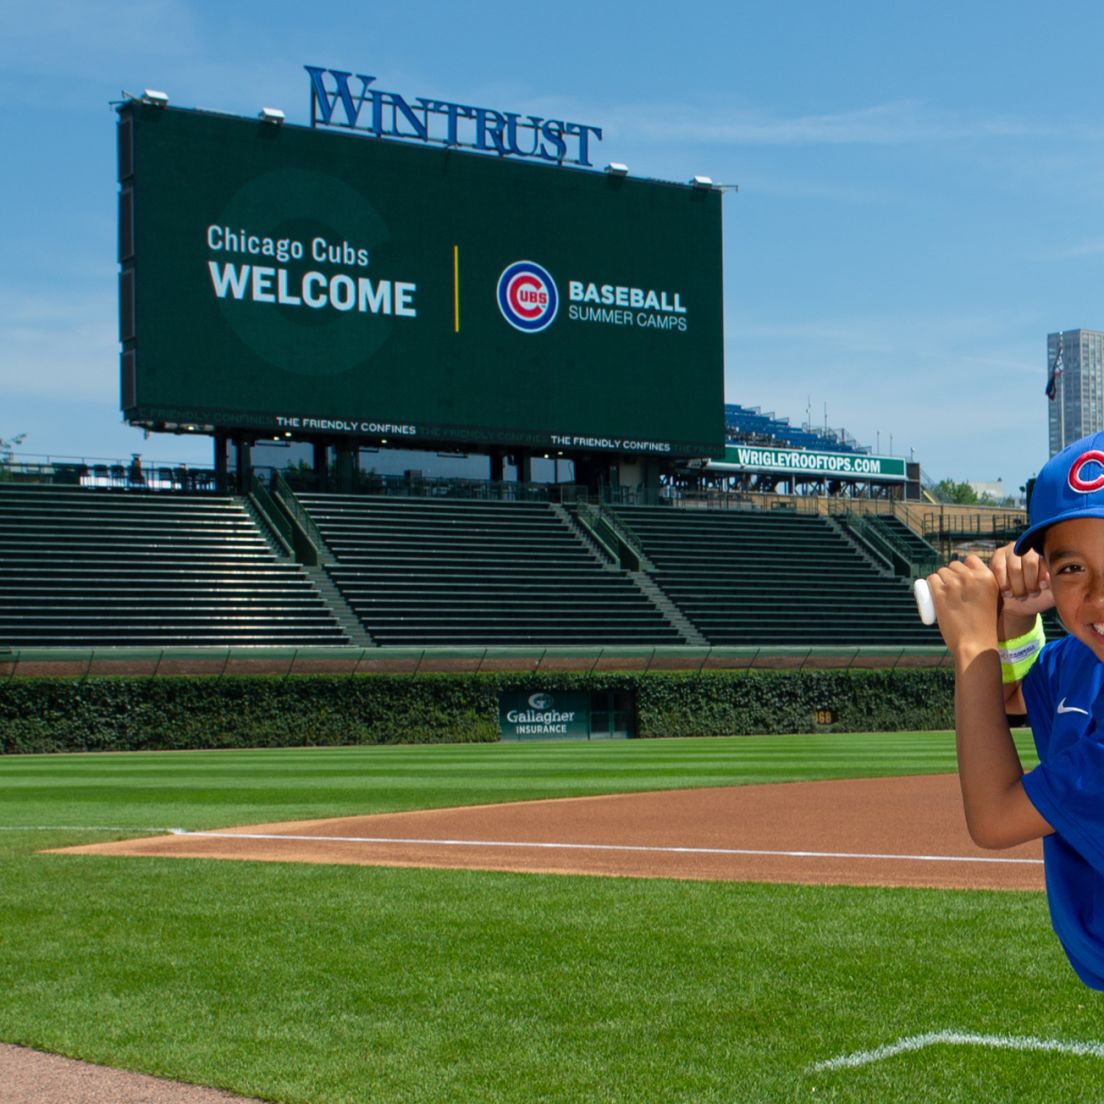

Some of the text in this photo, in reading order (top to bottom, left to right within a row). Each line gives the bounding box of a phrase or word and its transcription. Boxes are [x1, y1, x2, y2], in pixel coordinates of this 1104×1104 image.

[303, 65, 603, 167] WINTRUST
[207, 224, 369, 266] Chicago Cubs
[207, 260, 417, 317] WELCOME
[568, 280, 687, 313] BASEBALL
[568, 304, 688, 331] SUMMER CAMPS
[276, 416, 416, 435] THE FRIENDLY CONFINES
[551, 434, 571, 445] THE
[573, 436, 620, 448] FRIENDLY
[623, 439, 670, 452] CONFINES
[506, 709, 575, 725] Gallagher
[815, 710, 831, 724] 68
[516, 724, 567, 735] INSURANCE
